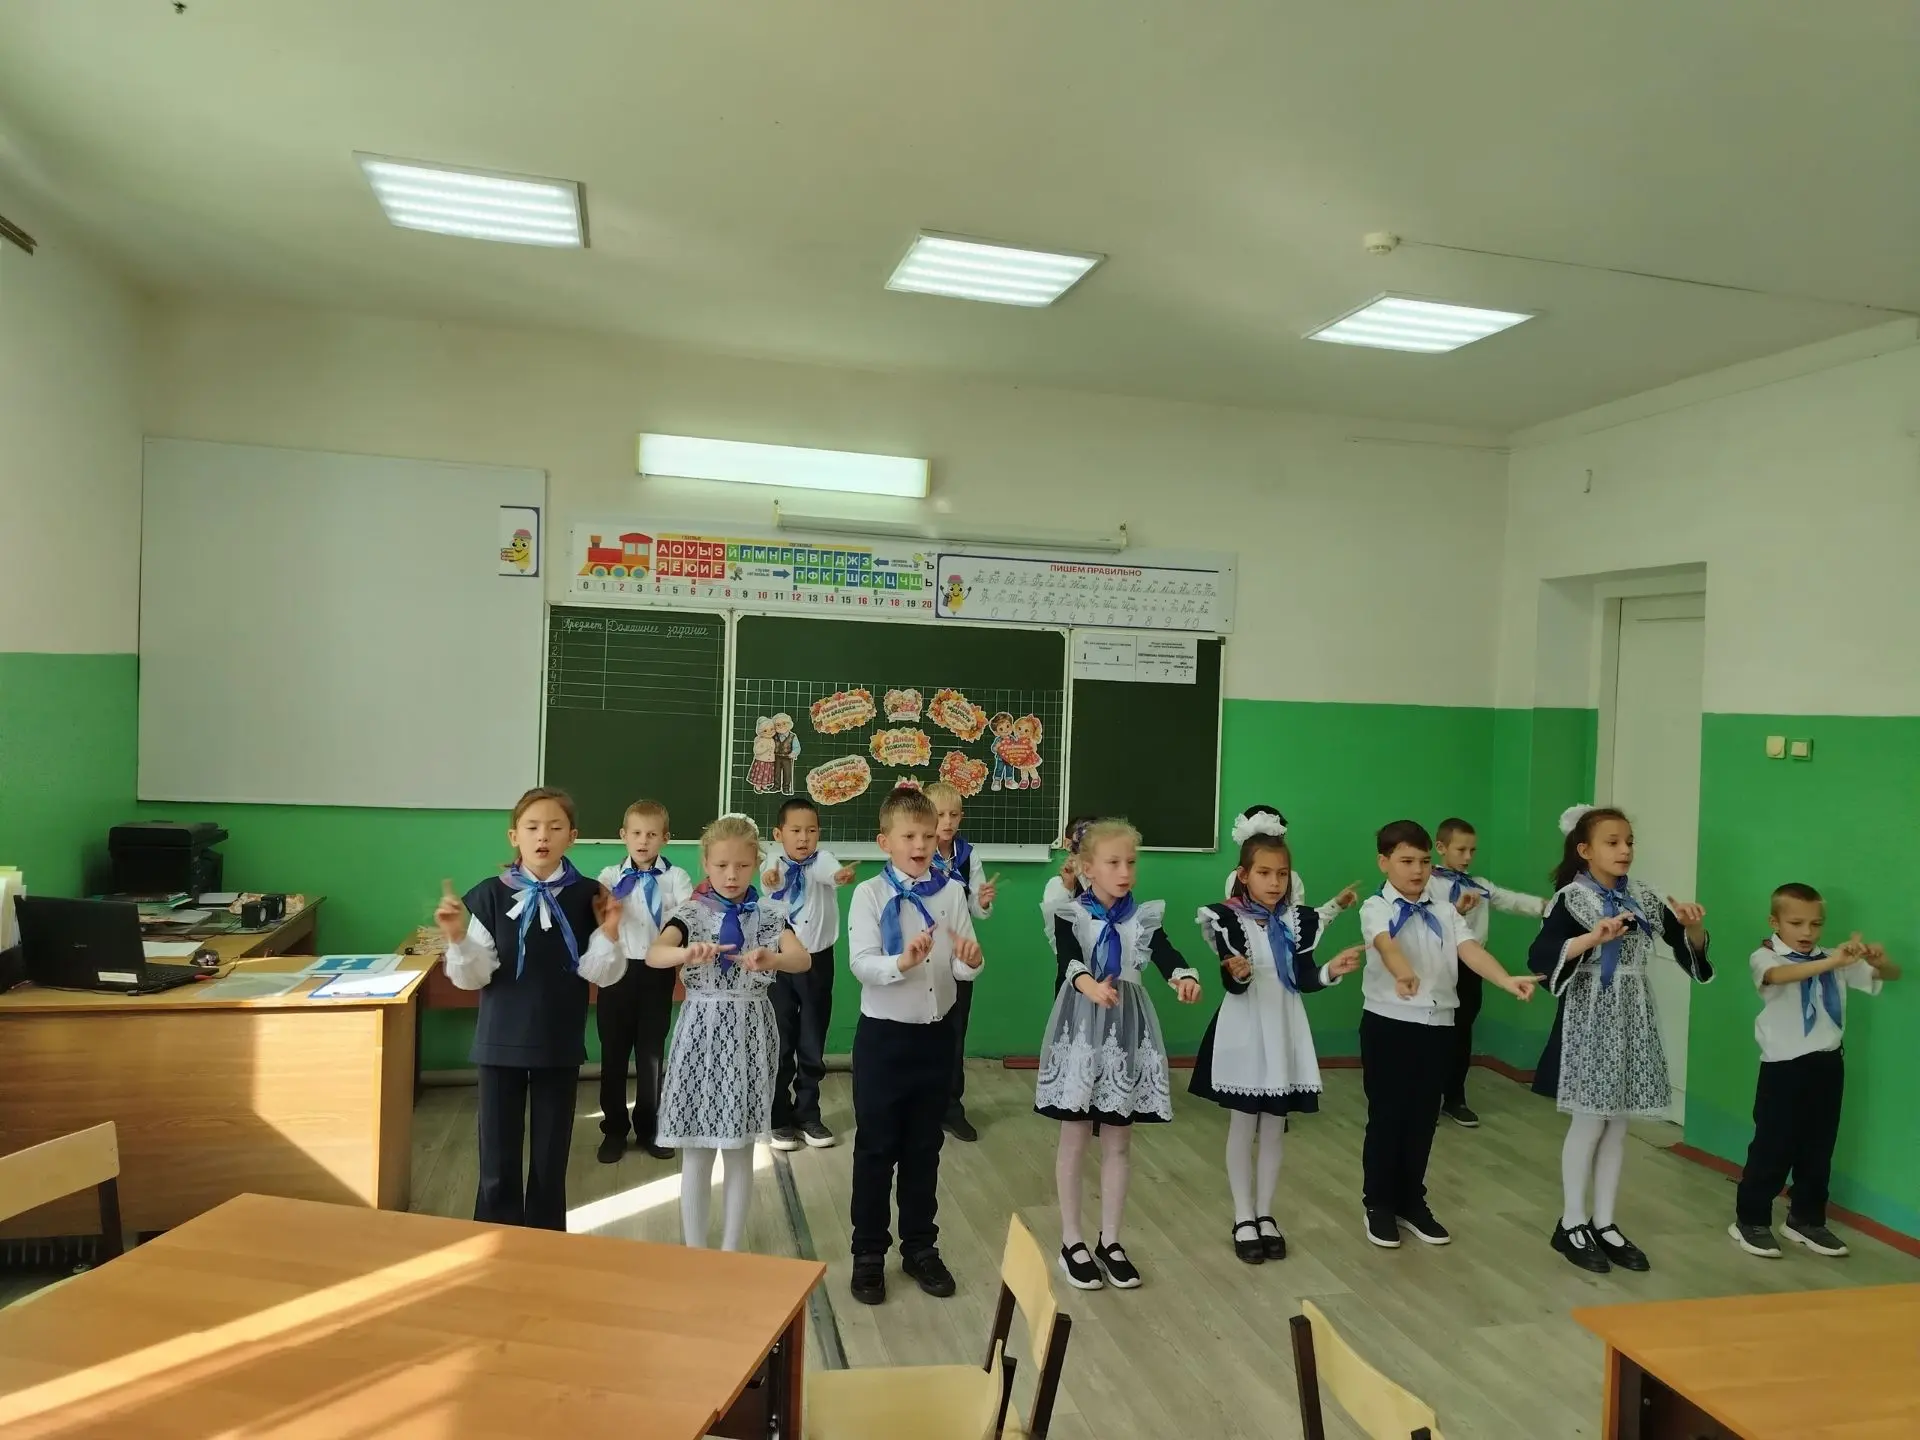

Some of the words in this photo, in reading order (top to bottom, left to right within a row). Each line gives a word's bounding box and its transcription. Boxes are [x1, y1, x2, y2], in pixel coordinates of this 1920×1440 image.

[1050, 564, 1086, 574] ПИШЕМ
[1088, 567, 1142, 577] ПРАВИЛЬНО
[562, 618, 604, 634] Предмет
[607, 620, 660, 634] Домашнее
[666, 625, 709, 639] задание
